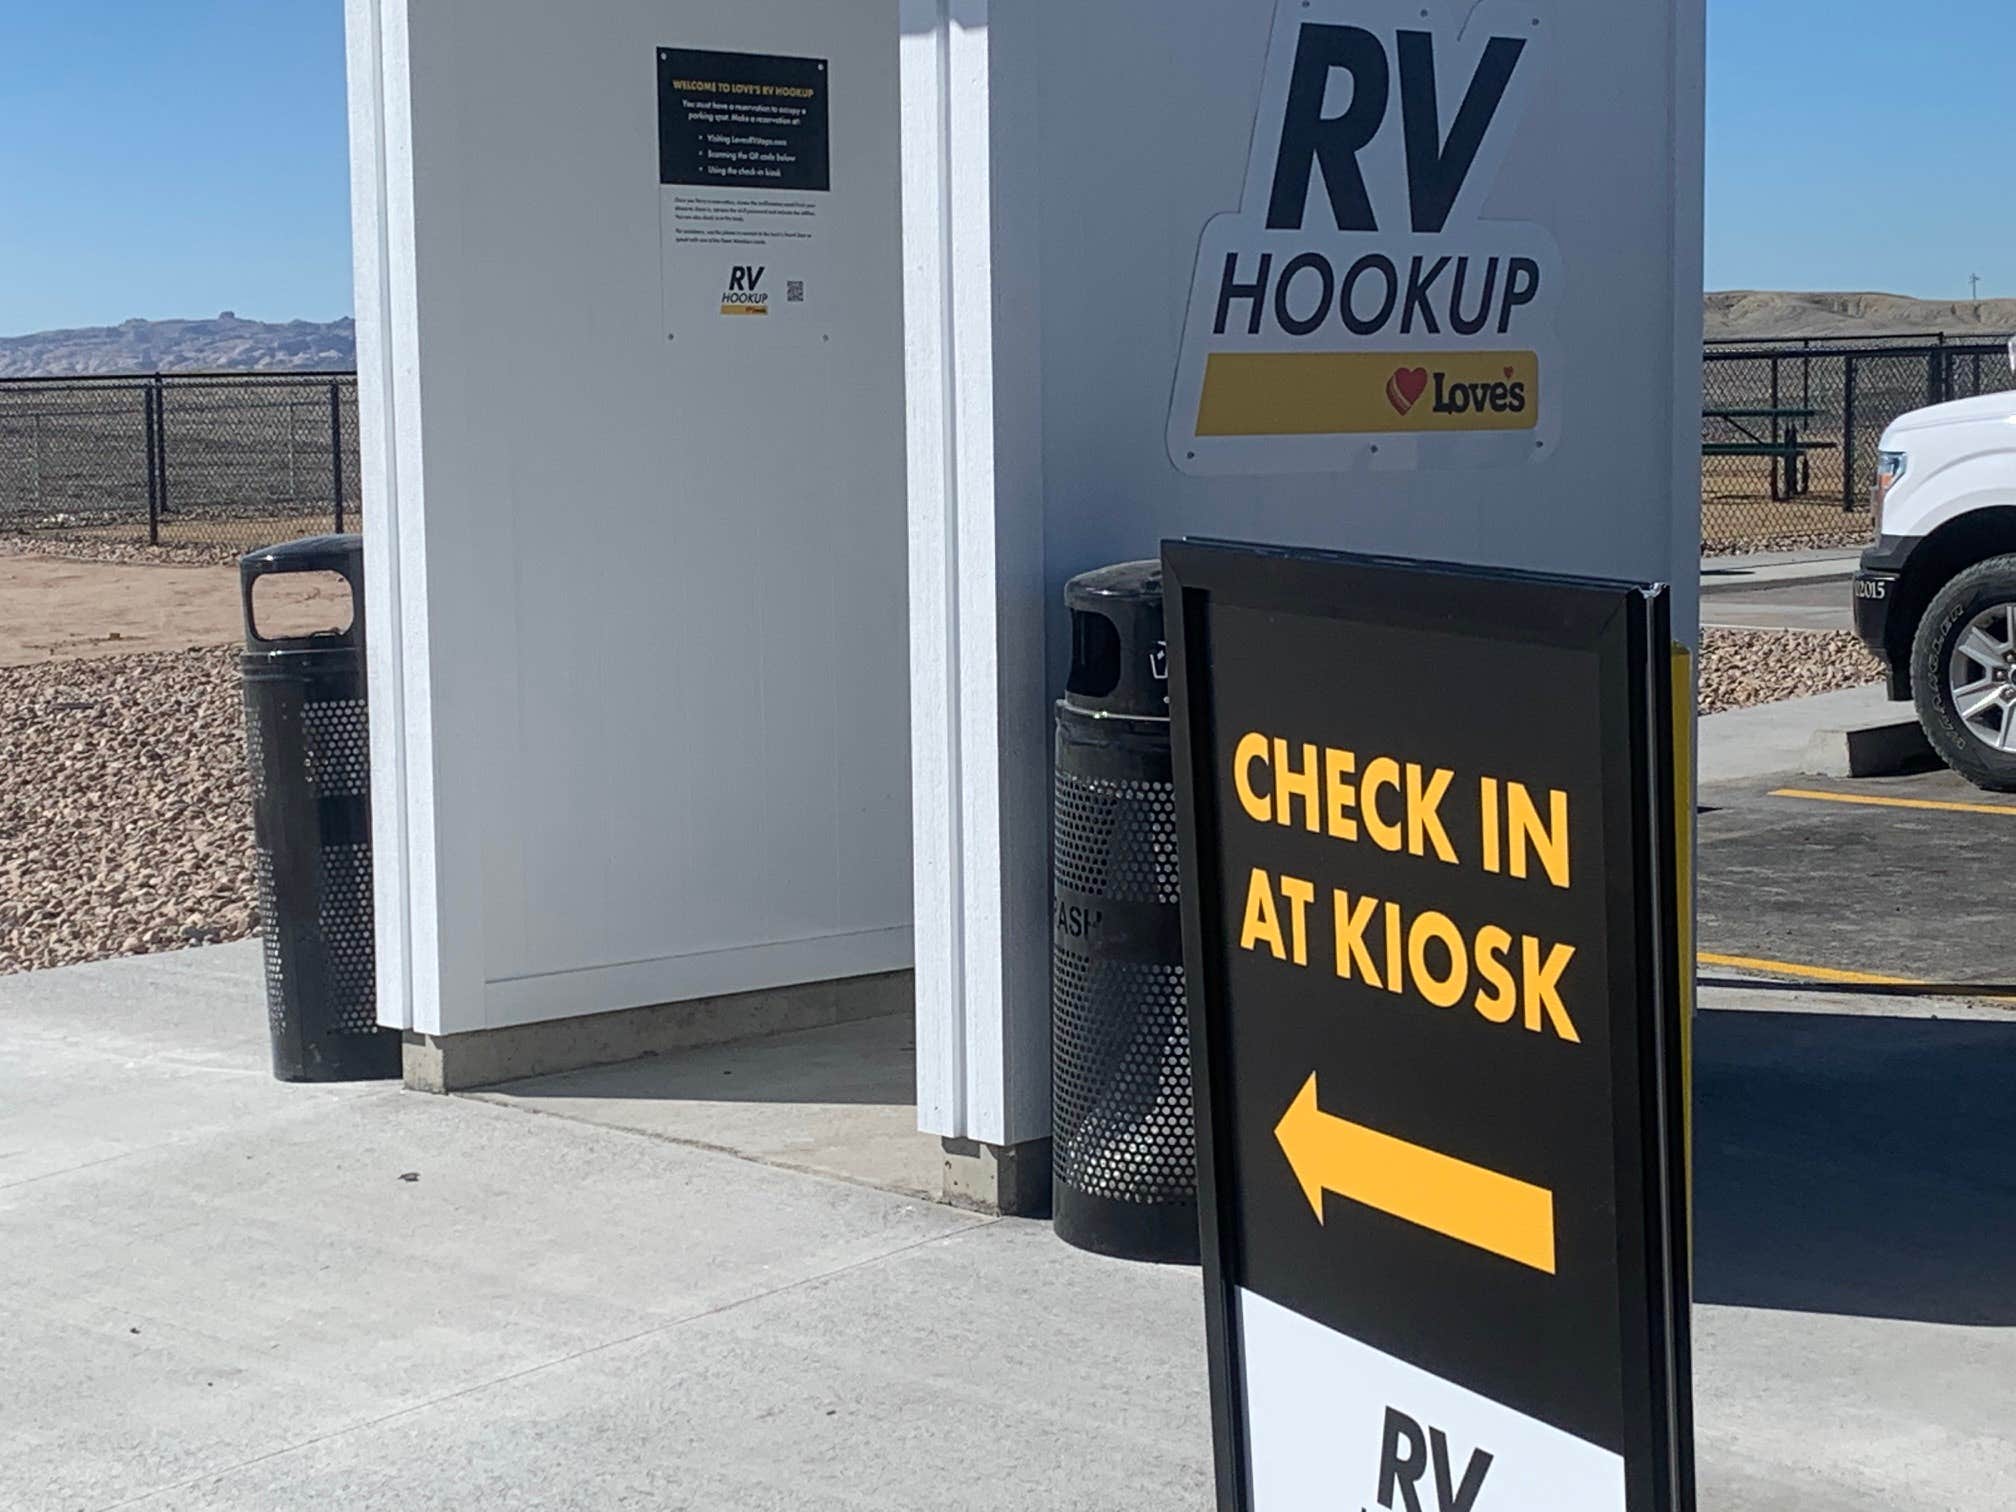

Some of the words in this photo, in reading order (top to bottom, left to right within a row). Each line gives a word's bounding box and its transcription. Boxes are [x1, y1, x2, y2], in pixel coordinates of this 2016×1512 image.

[672, 80, 716, 92] WELCOME
[718, 82, 730, 92] TO
[762, 86, 775, 95] RV
[776, 87, 814, 98] HOOKUP
[1265, 22, 1527, 233] RV
[721, 292, 768, 303] HOOKUP
[728, 266, 765, 291] RV
[1212, 252, 1540, 336] HOOKUP
[1233, 732, 1459, 864] CHECK
[1480, 776, 1570, 889] IN
[1240, 867, 1314, 967] AT
[1333, 888, 1581, 1044] KIOSK
[1377, 1405, 1494, 1512] RV
